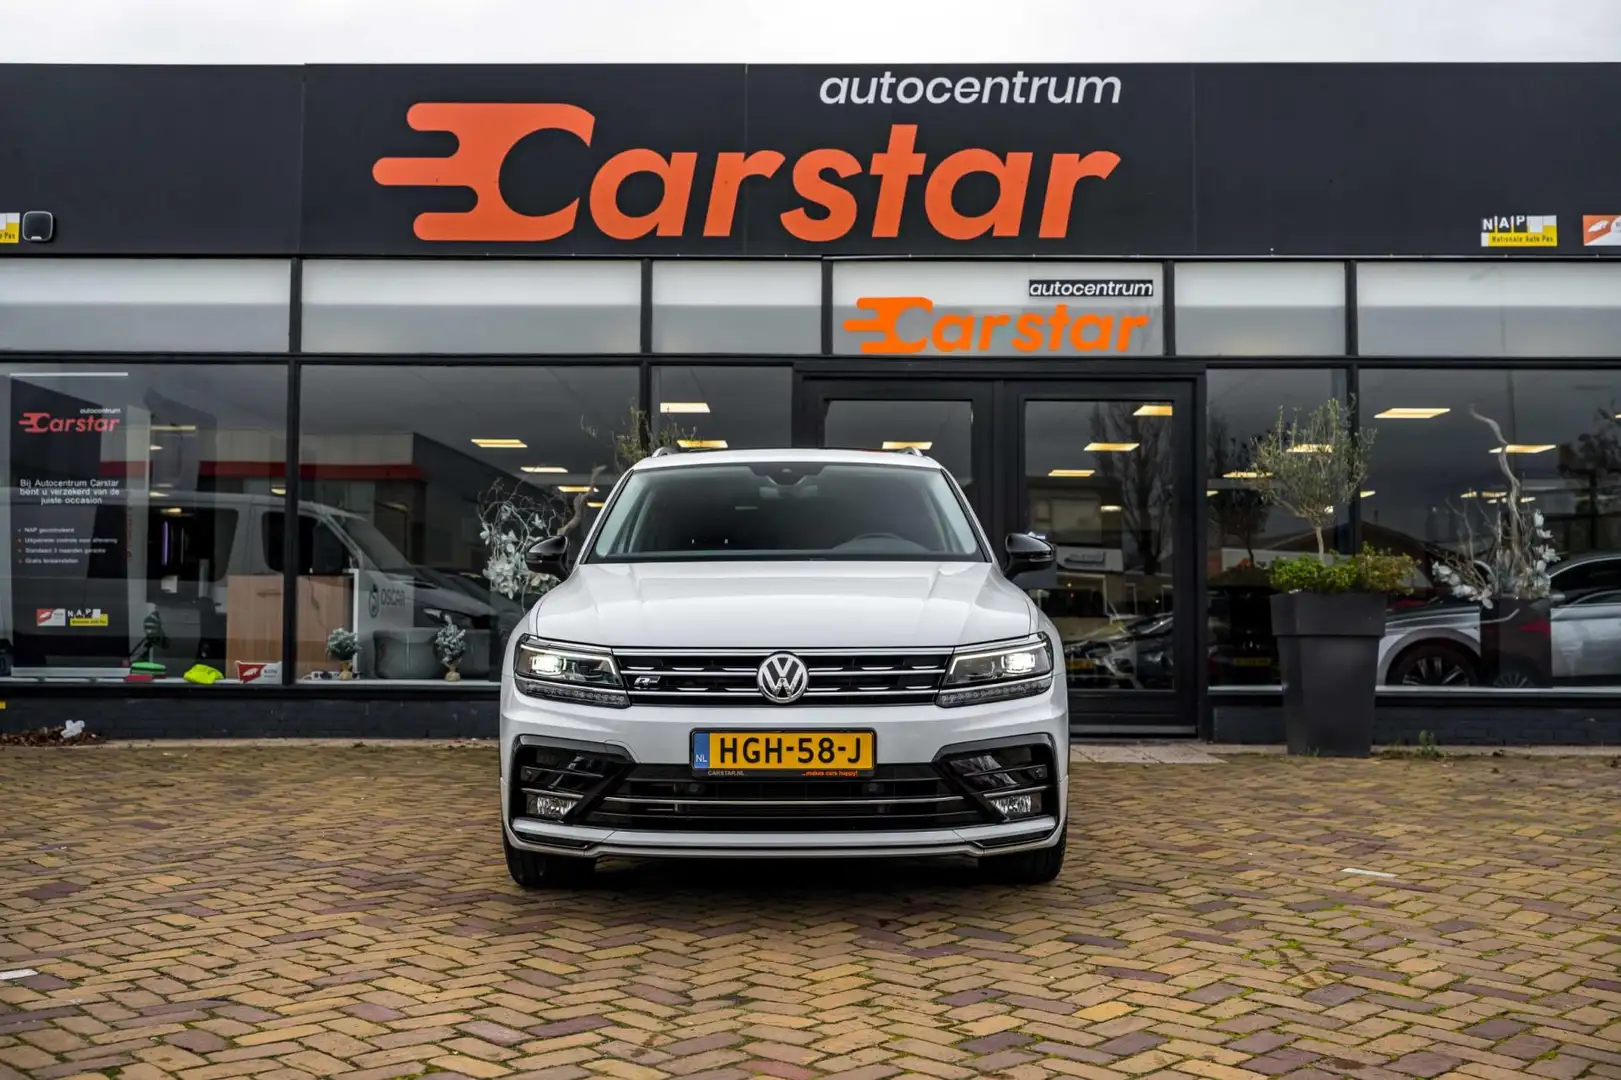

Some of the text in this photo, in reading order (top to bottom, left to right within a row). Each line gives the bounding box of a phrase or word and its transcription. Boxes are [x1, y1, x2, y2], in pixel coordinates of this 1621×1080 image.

[819, 70, 1121, 105] autocentrum
[372, 102, 1121, 242] Carstar
[1030, 281, 1152, 296] autocentrum
[18, 412, 120, 433] Carstar
[20, 479, 119, 488] Bij Autocentrum Carstar
[695, 737, 861, 764] NL HGH-58-J
